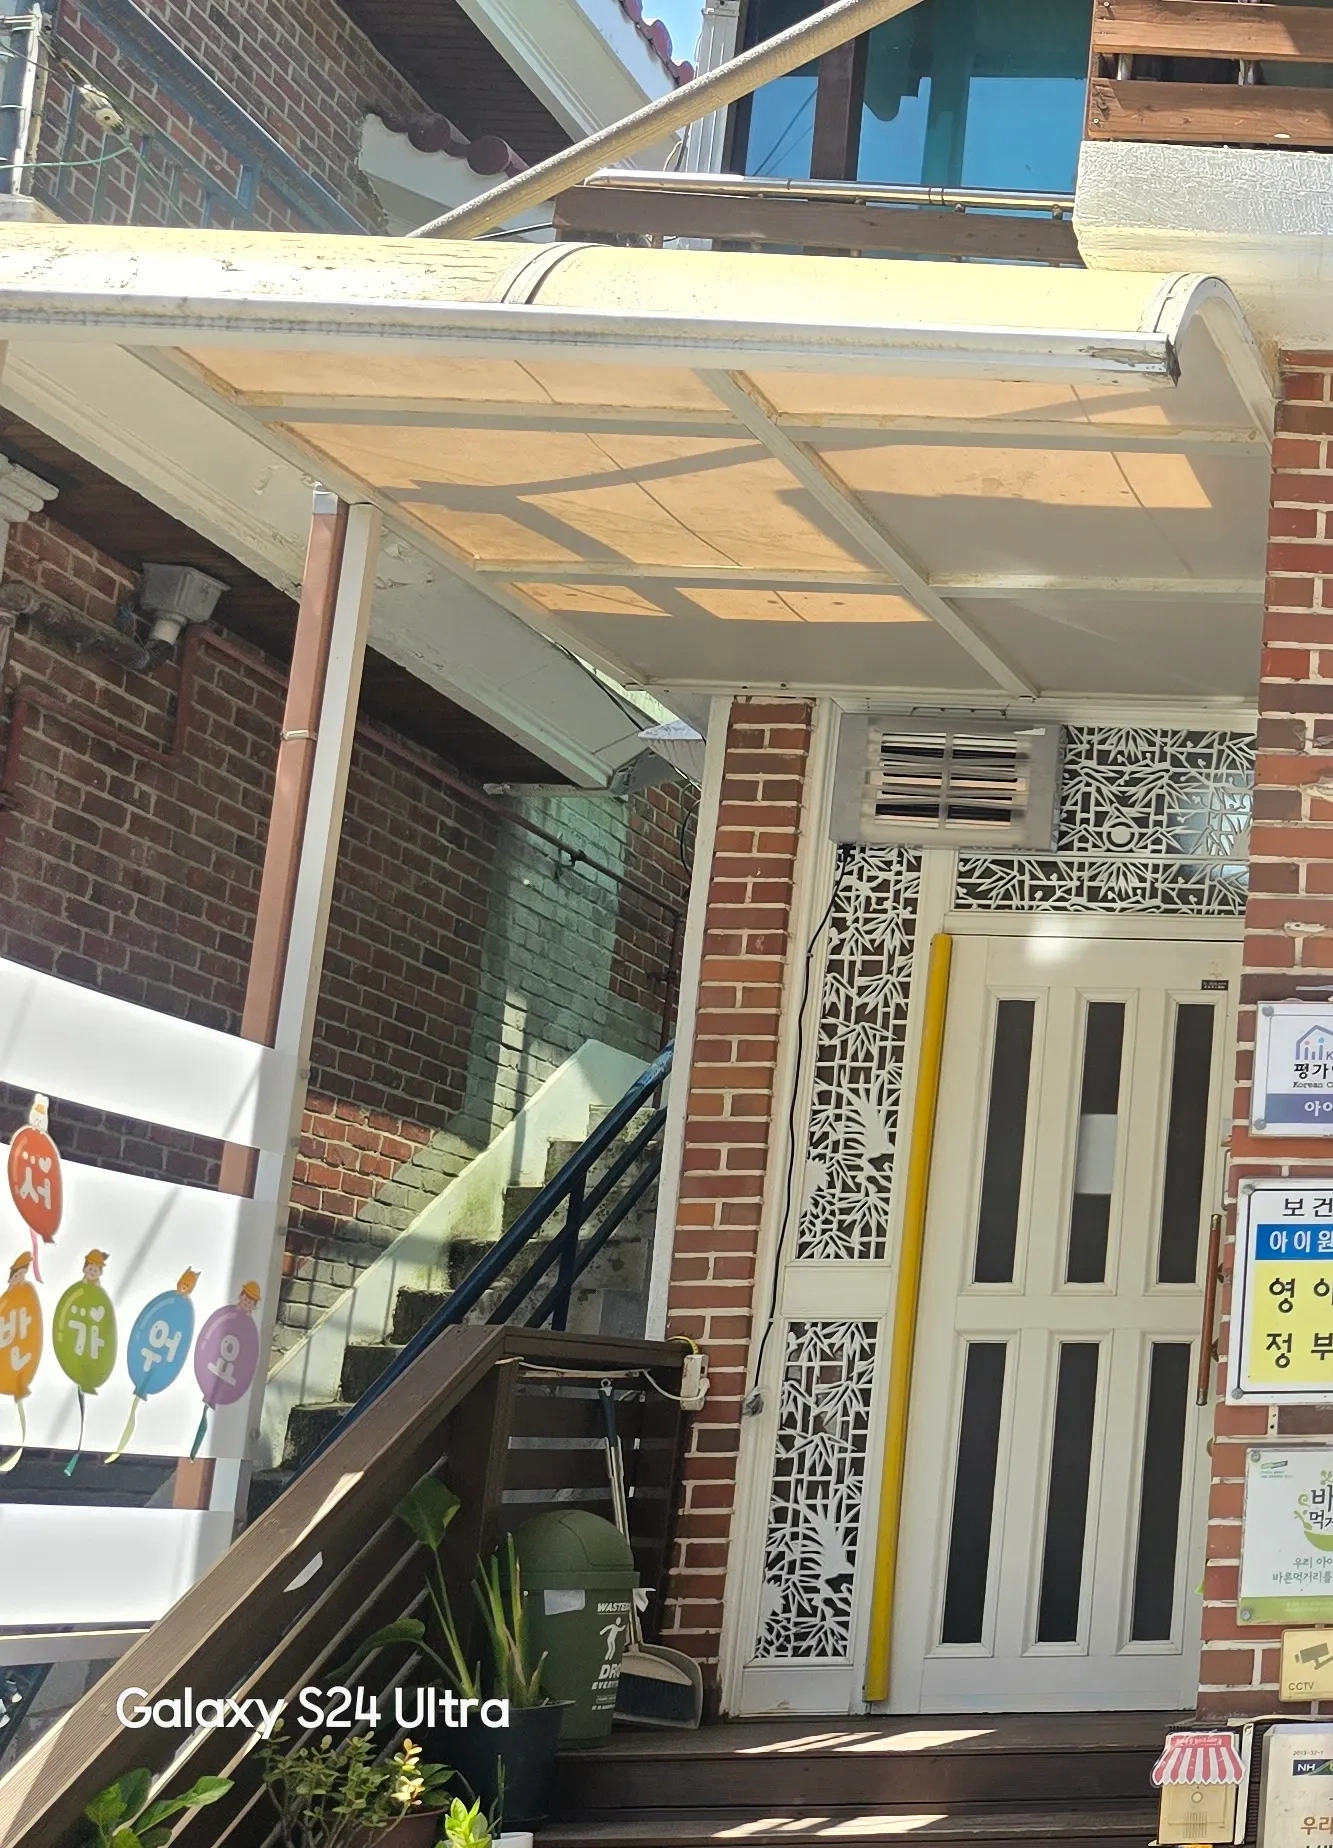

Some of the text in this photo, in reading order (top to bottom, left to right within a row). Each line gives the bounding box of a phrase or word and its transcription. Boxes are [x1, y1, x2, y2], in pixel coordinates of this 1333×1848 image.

[1292, 1556, 1313, 1569] 우리
[1272, 1571, 1333, 1584] 바른먹거리를
[1288, 1682, 1314, 1691] CCTV
[1297, 1763, 1316, 1771] NH
